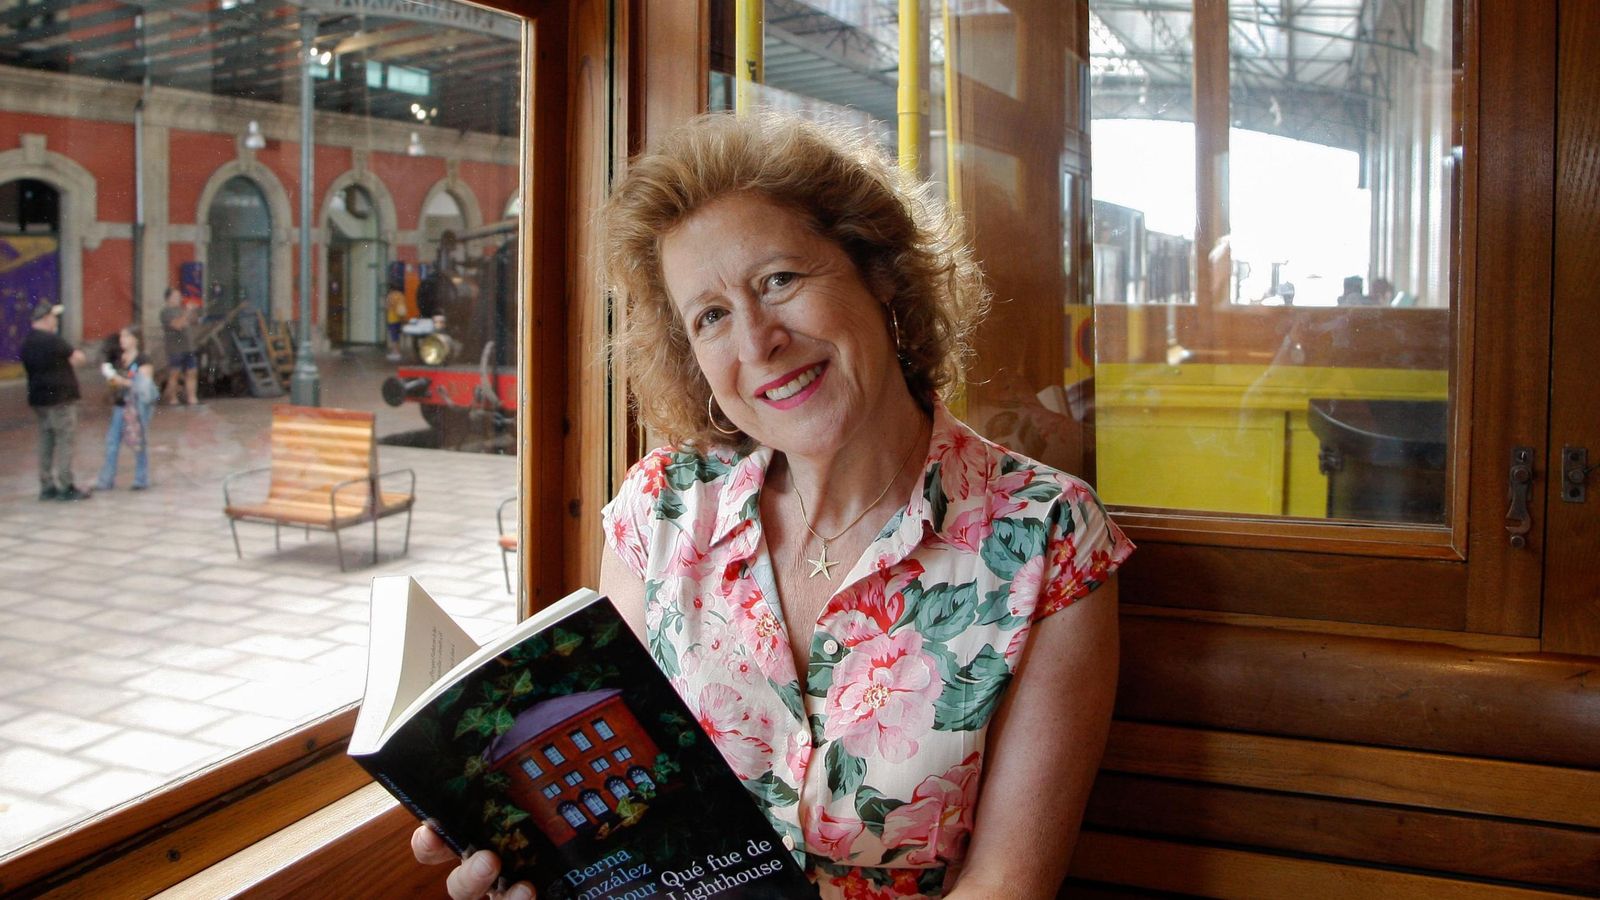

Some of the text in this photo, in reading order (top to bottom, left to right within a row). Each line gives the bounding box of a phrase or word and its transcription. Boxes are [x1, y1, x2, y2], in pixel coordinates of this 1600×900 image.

[564, 849, 632, 887] Berna
[567, 863, 652, 900] onzález
[660, 839, 772, 887] Qué fue de
